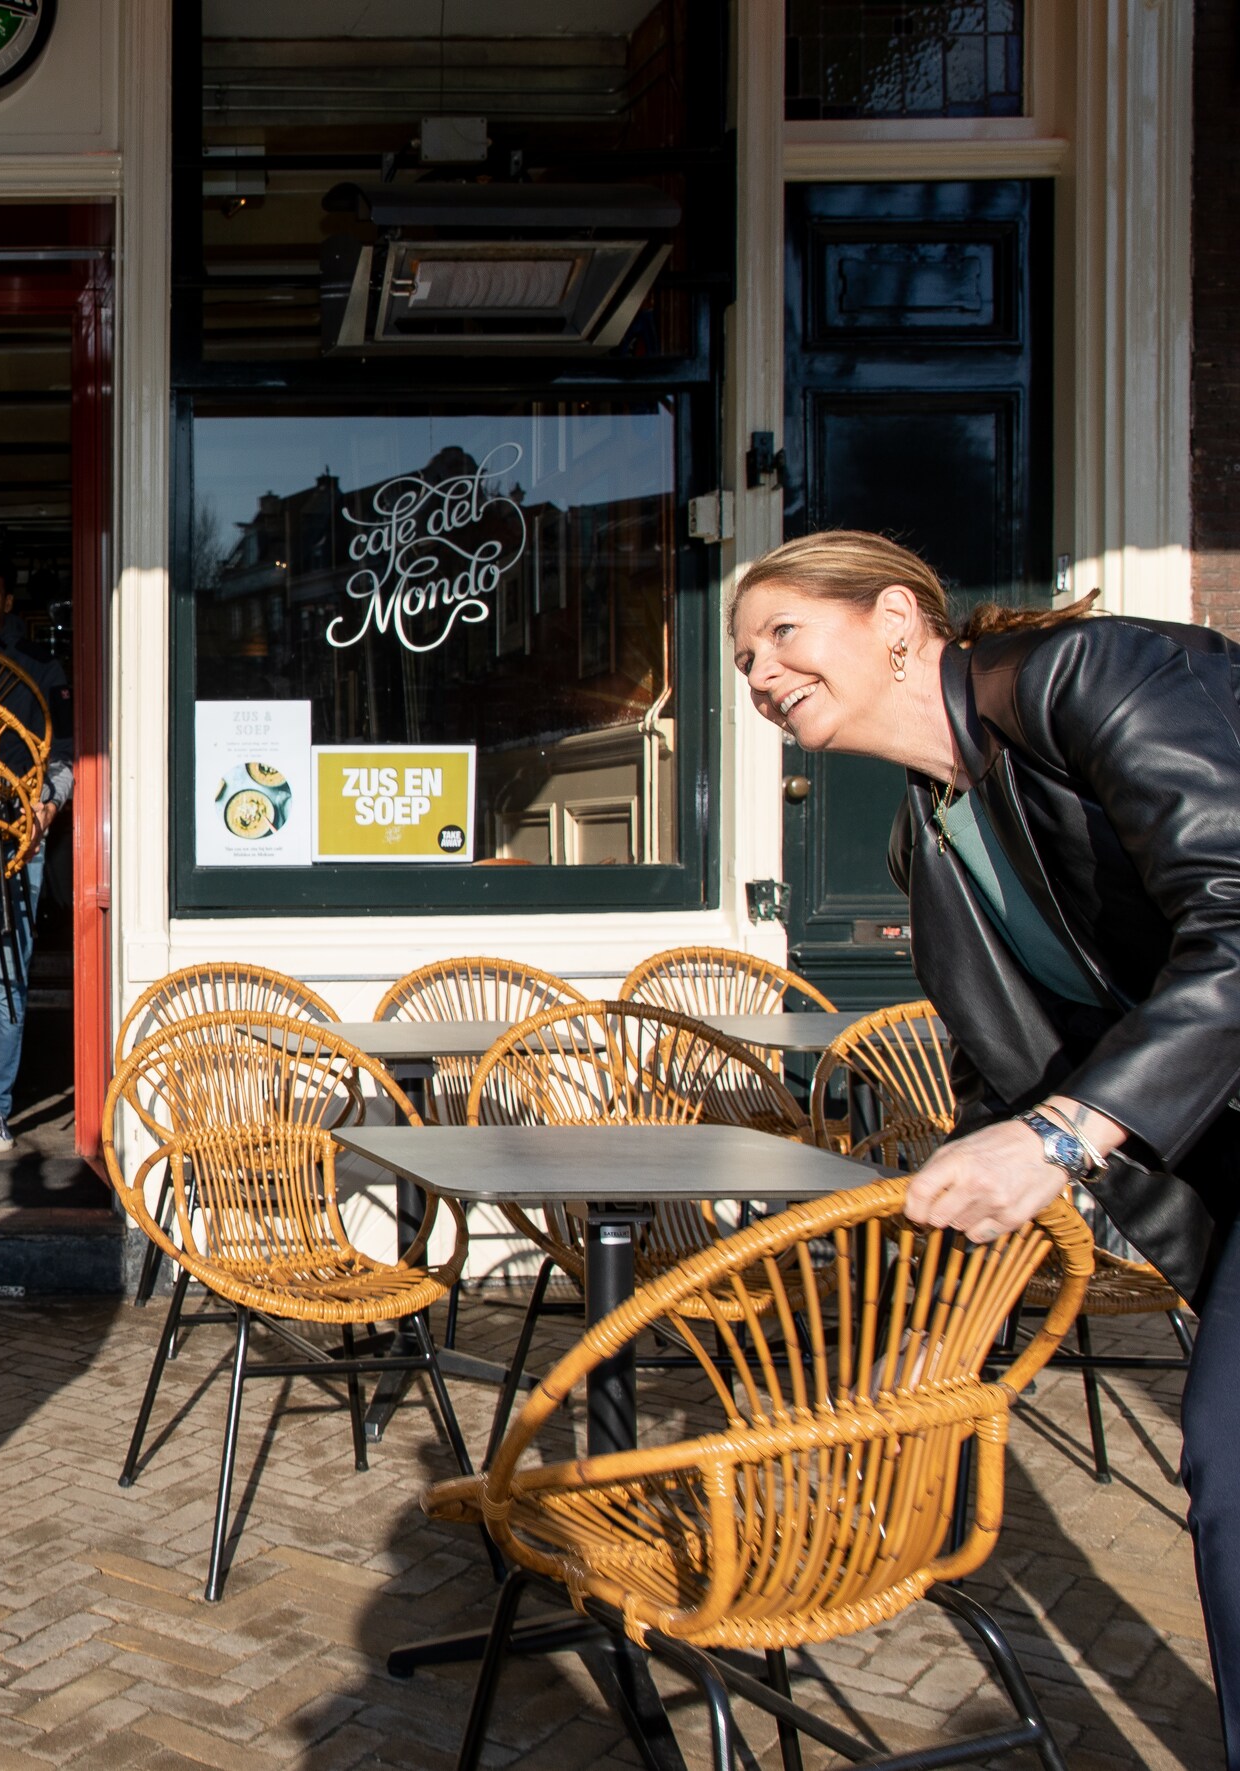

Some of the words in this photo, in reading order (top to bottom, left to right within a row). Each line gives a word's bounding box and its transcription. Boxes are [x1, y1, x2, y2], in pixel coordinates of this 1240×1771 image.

[326, 536, 526, 653] Mondo
[233, 711, 258, 722] ZUS
[265, 711, 272, 722] &
[235, 725, 270, 735] SOEP
[342, 767, 398, 797] ZUS
[404, 767, 442, 797] EN
[355, 796, 431, 825] SOEP
[441, 830, 462, 840] TAKE
[440, 839, 463, 848] AWAY
